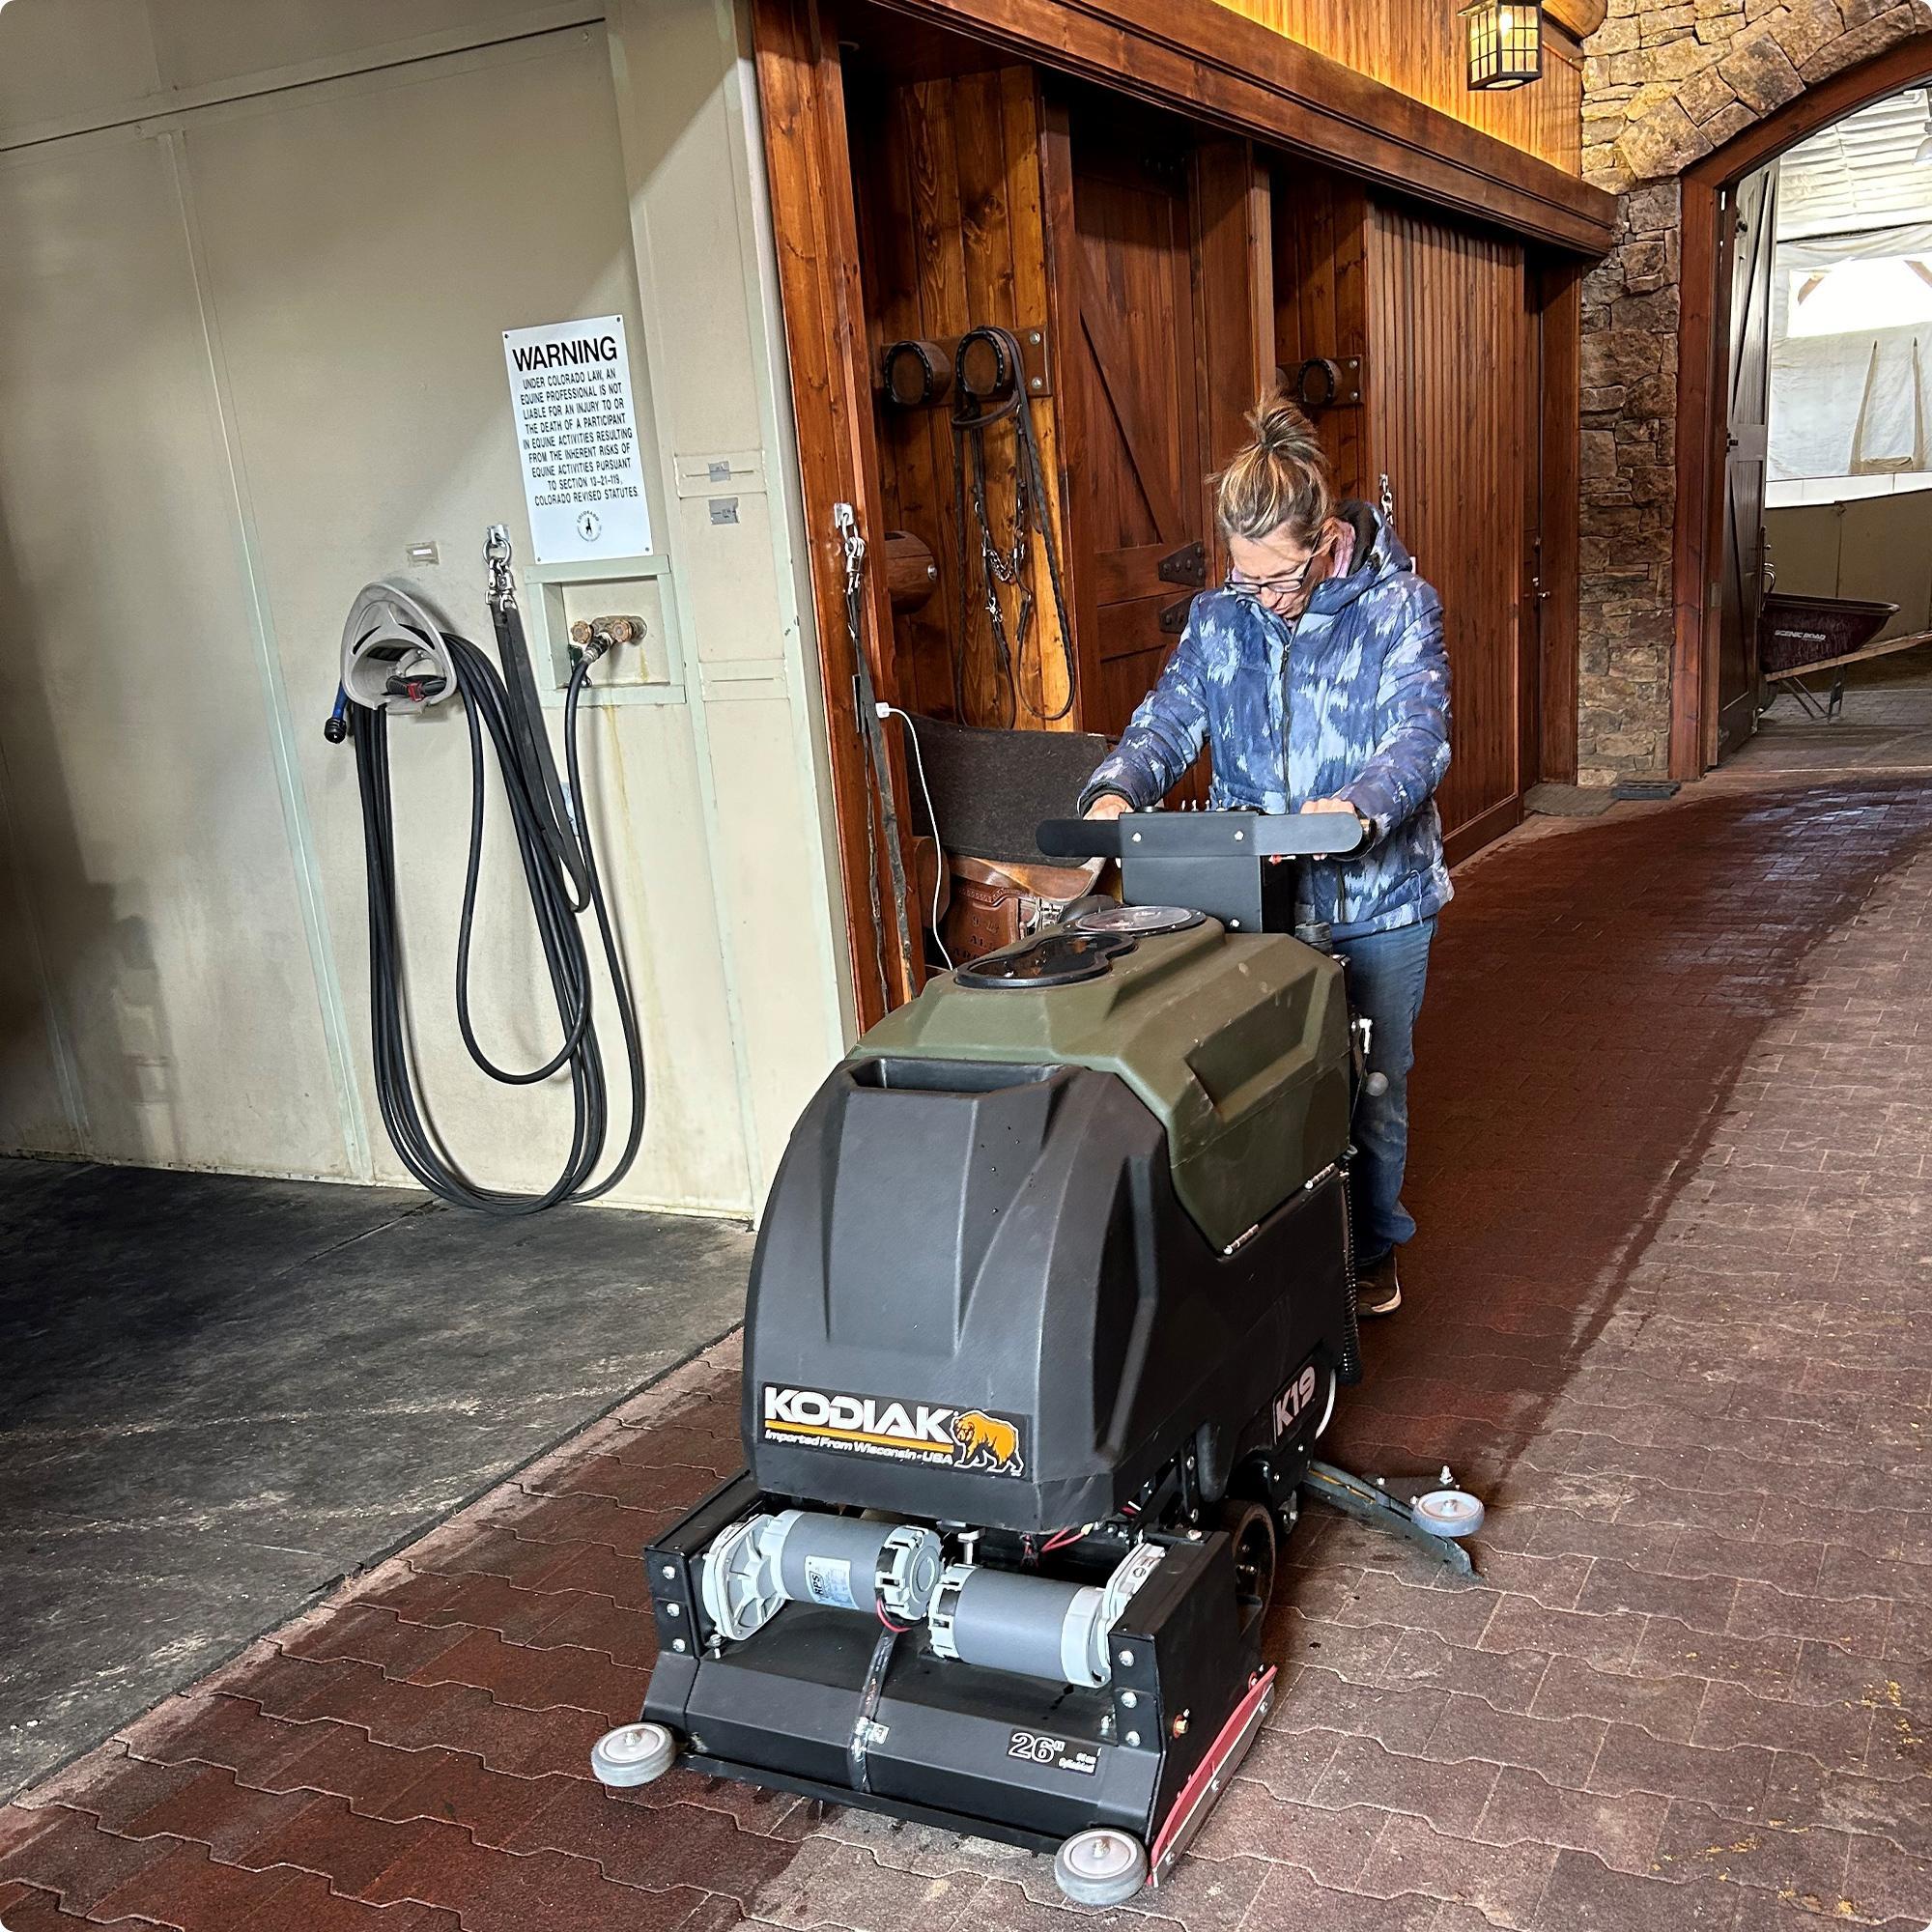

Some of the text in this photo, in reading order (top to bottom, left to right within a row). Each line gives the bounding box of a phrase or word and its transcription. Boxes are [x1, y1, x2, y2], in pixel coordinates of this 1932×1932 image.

[512, 336, 617, 372] WARNING
[523, 368, 616, 389] UNDER COLORADO LAW, AN
[521, 383, 622, 405] EQUINE PROFESSIONAL IS NOT
[523, 398, 624, 420] LIABLE FOR AN INJURY TO OR
[526, 413, 626, 434] THE DEATH OF A PARTICIPANT
[524, 427, 633, 450] IN EQUINE ACTIVITIES RESULTING
[528, 442, 631, 464] FROM THE INHERENT RISKS OF
[532, 457, 631, 478] EQUINE ACTIVITIES PURSUANT
[548, 480, 556, 492] TO
[559, 476, 588, 491] SECTION
[534, 493, 571, 506] COLORADO
[573, 490, 602, 503] REVISED
[1276, 1366, 1315, 1436] K19
[764, 1386, 954, 1444] KODIAK
[764, 1430, 820, 1447] Imported
[819, 1437, 853, 1452] From
